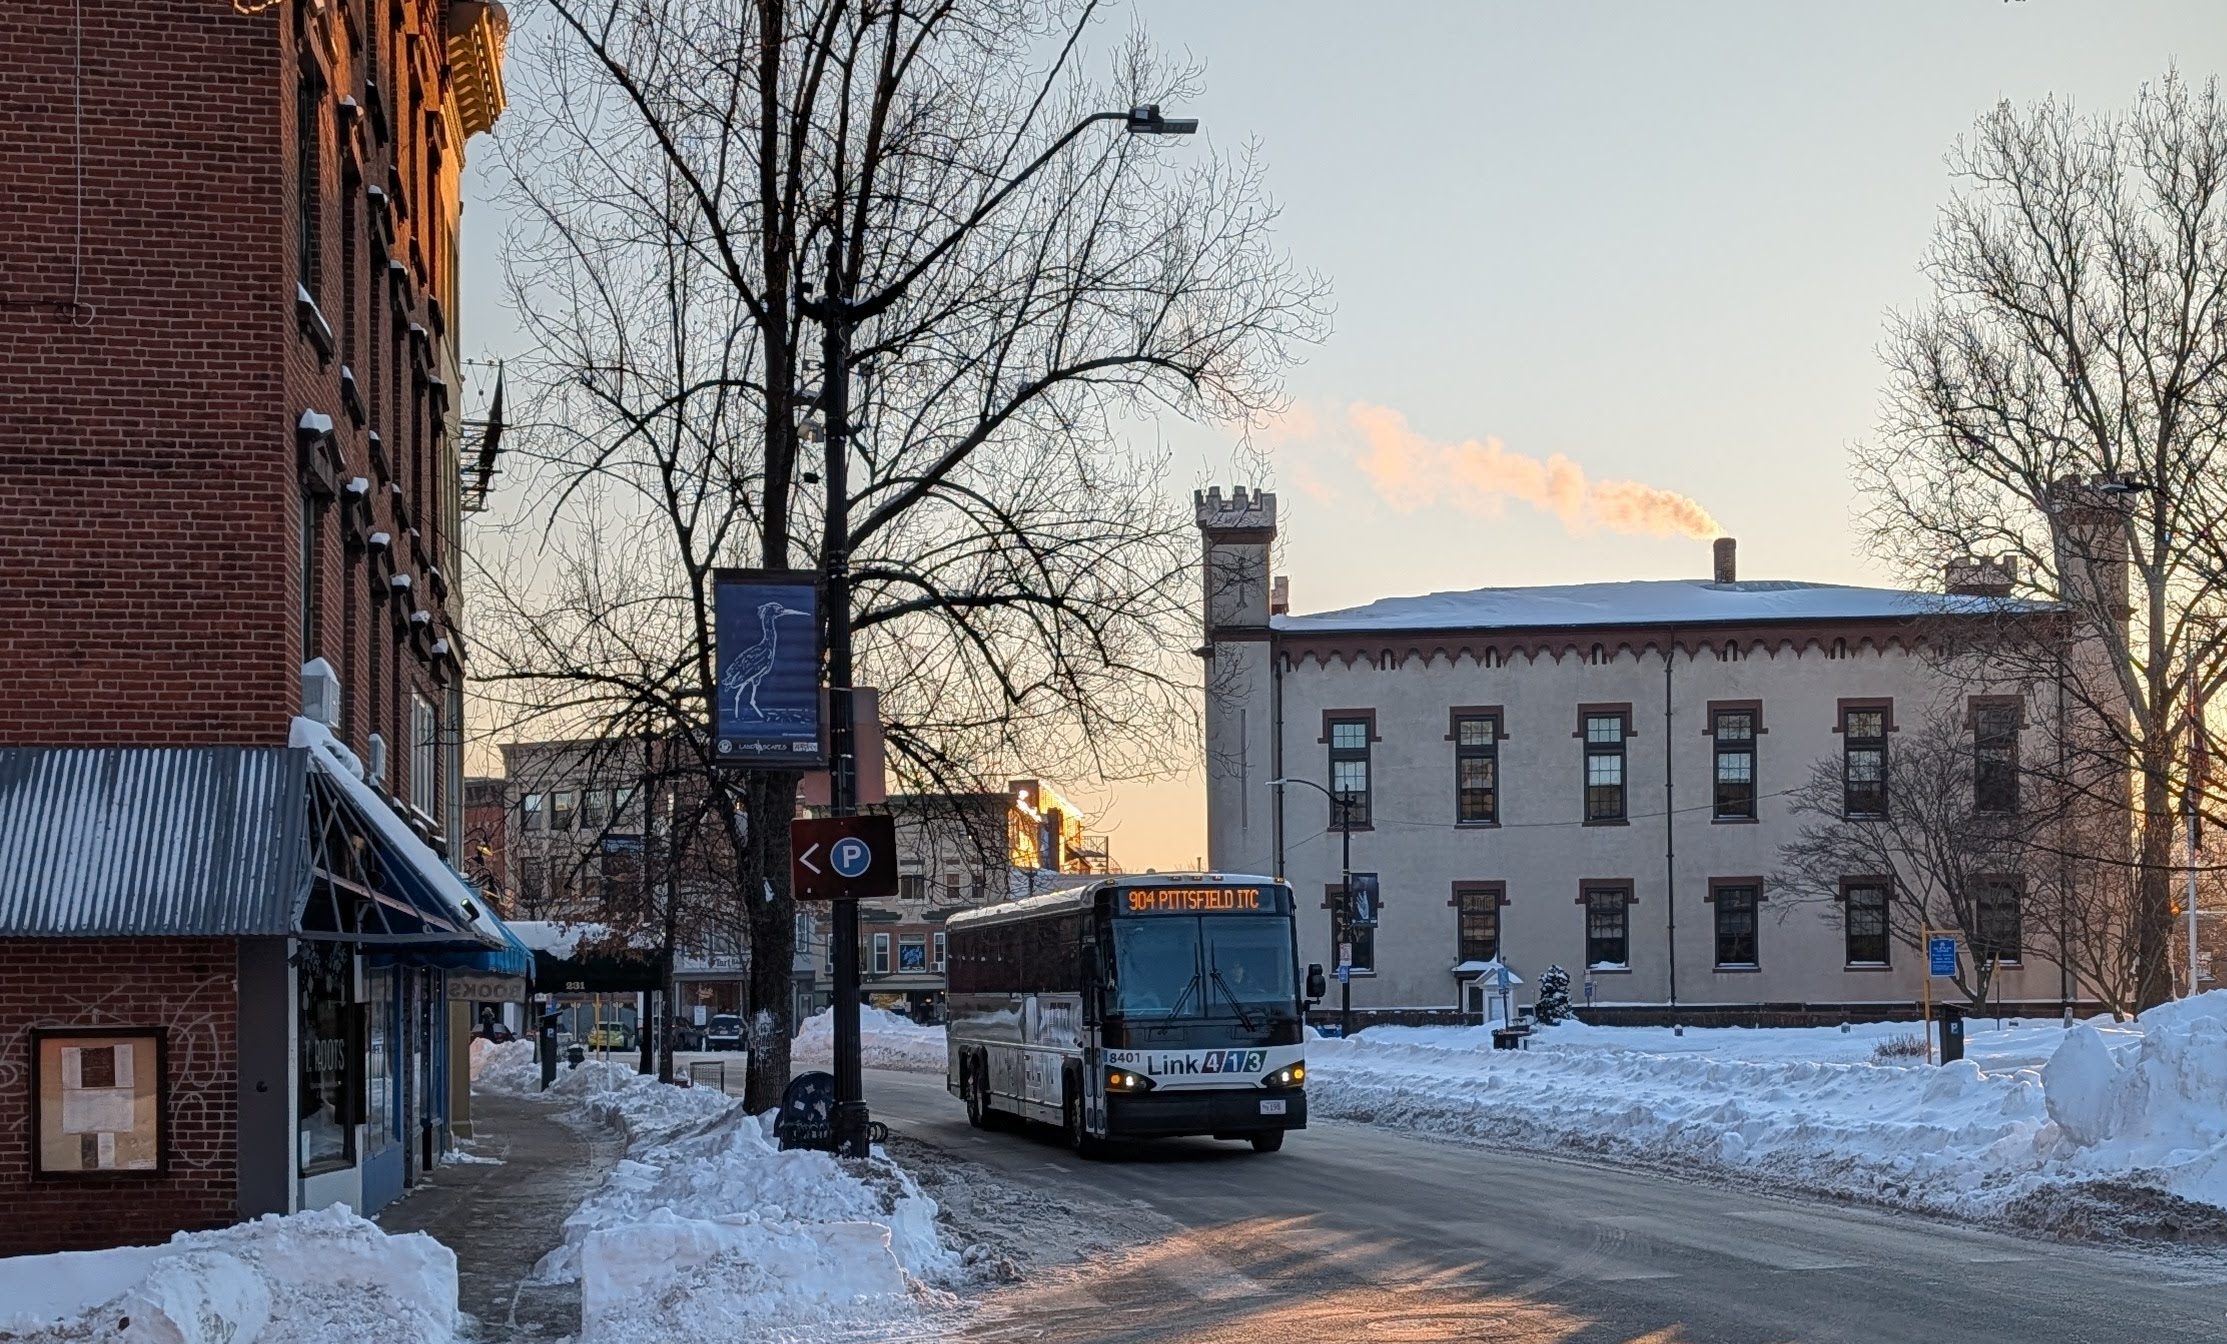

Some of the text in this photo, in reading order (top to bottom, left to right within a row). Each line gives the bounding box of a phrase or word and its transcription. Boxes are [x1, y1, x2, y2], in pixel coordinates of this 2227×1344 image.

[843, 845, 861, 868] P
[1128, 889, 1260, 910] 904 PITTSFIELD ITC
[566, 981, 586, 990] 231
[314, 1038, 345, 1072] ROOTS
[1109, 1052, 1140, 1064] 8401
